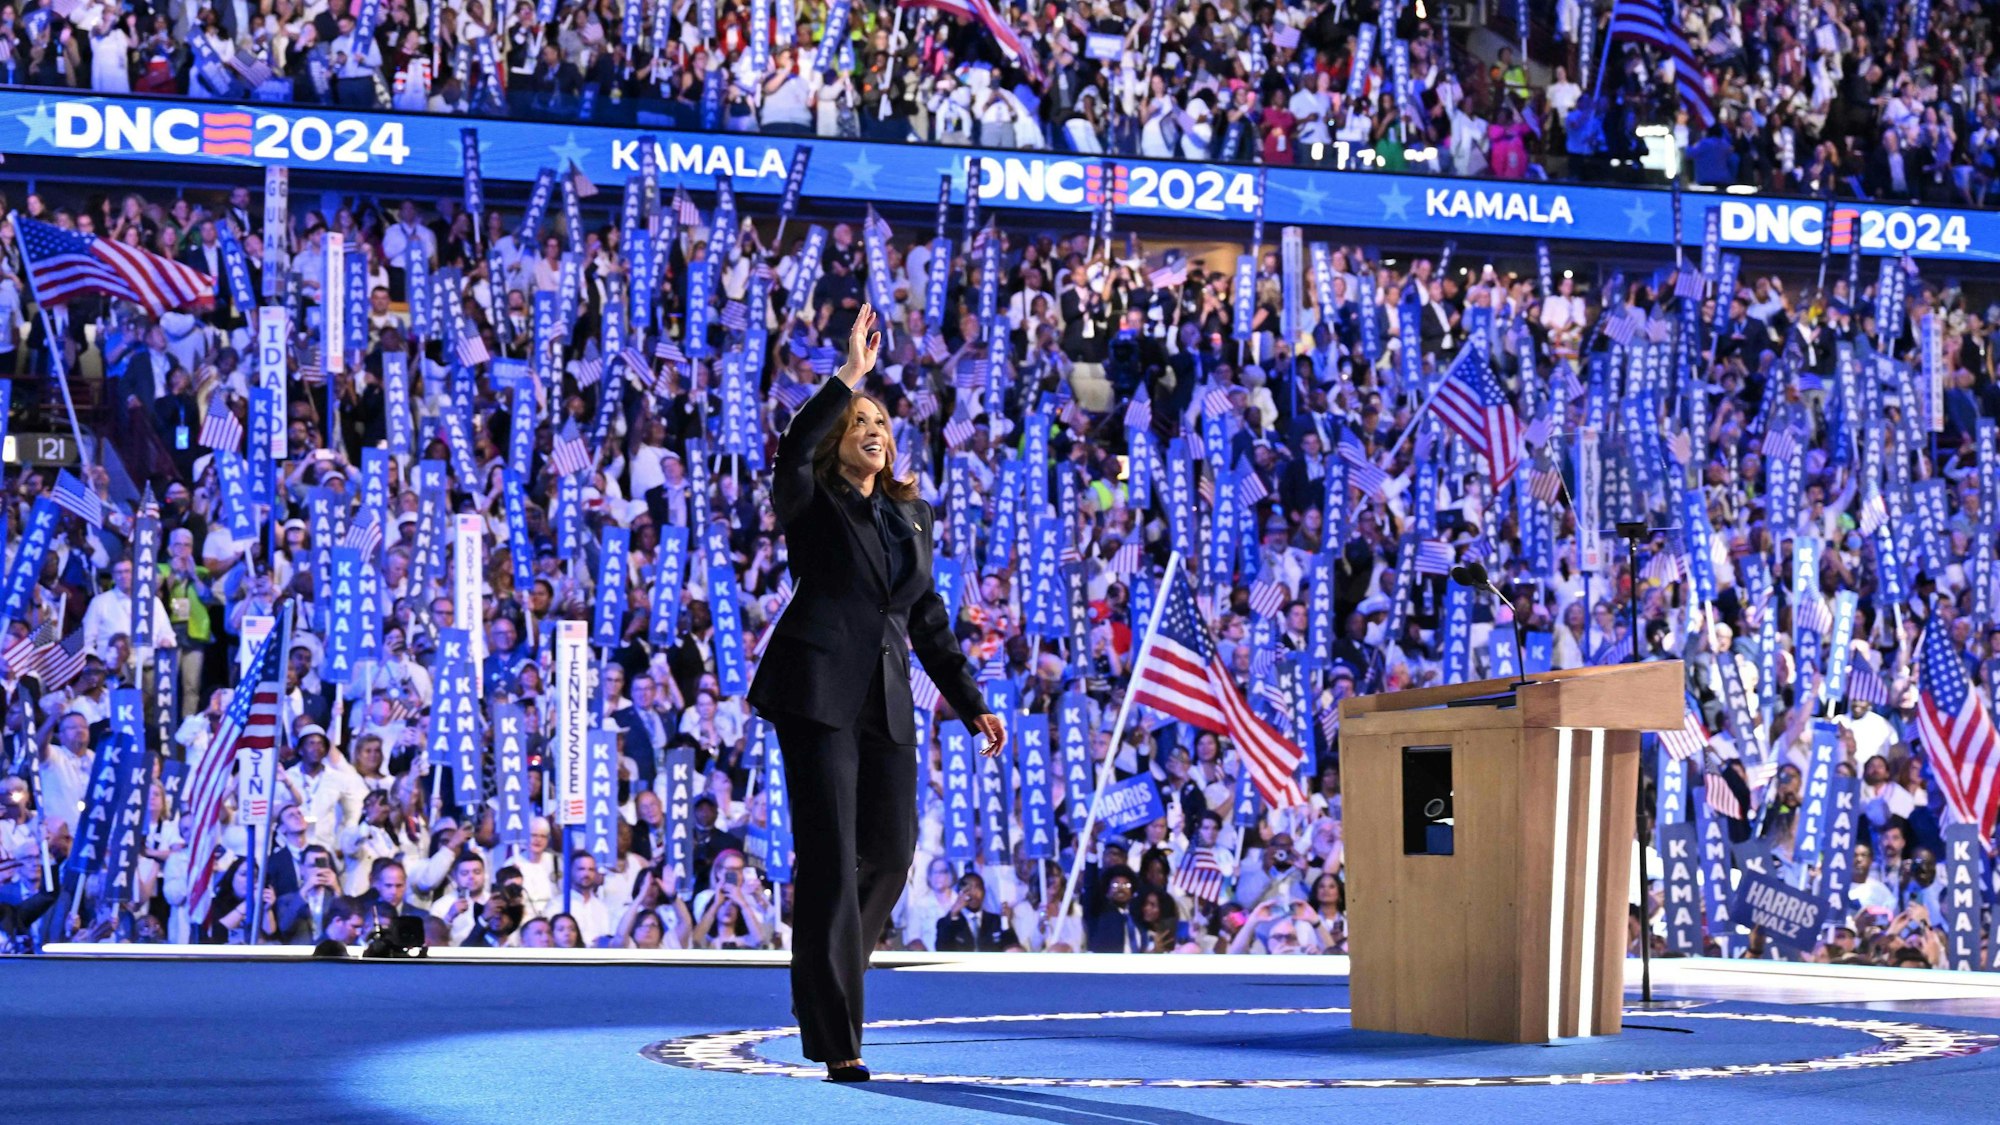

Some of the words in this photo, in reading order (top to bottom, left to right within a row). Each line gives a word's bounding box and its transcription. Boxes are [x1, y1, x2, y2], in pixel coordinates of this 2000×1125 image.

[54, 102, 199, 155] DNC
[254, 115, 410, 165] 2024
[1129, 167, 1258, 214] 2024
[1426, 188, 1574, 225] KAMALA
[1720, 201, 1823, 246] DNC
[1860, 210, 1971, 252] 2024
[352, 262, 363, 341] KAMALA
[410, 249, 427, 326] KAMALA
[634, 238, 647, 318] KAMALA
[690, 271, 705, 350] KAMALA
[928, 246, 947, 318] KAMALA
[1239, 263, 1253, 334] KAMALA
[1315, 248, 1336, 316] KAMALA
[1360, 284, 1377, 353] KAMALA
[991, 325, 1006, 408] KAMALA
[1402, 312, 1419, 382] KAMALA
[253, 399, 268, 493] KAMALA
[388, 361, 406, 445] KAMALA
[515, 388, 532, 475] KAMALA
[727, 362, 743, 444] KAMALA
[1693, 388, 1706, 461] KAMALA
[1898, 370, 1922, 441] KAMALA
[37, 438, 65, 459] 121
[446, 414, 478, 485] KAMALA
[1029, 424, 1043, 506] KAMALA
[507, 481, 530, 578] KAMALA
[951, 467, 968, 555] KAMALA
[993, 471, 1017, 557] KAMALA
[1172, 459, 1190, 548] KAMALA
[1214, 484, 1234, 574] KAMALA
[1327, 464, 1344, 549] KAMALA
[1690, 503, 1712, 590] KAMALA
[1914, 491, 1940, 569] KAMALA
[6, 511, 52, 609] KAMALA
[138, 530, 153, 635] KAMALA
[601, 540, 623, 636] KAMALA
[655, 538, 681, 633] KAMALA
[1033, 530, 1057, 625] KAMALA
[1975, 533, 1990, 614] KAMALA
[333, 561, 352, 671] KAMALA
[715, 581, 740, 683] KAMALA
[1070, 572, 1088, 668] KAMALA
[1315, 566, 1329, 659] KAMALA
[1762, 606, 1775, 698] KAMALA
[1830, 602, 1852, 690] KAMALA
[157, 658, 172, 757] KAMALA
[456, 677, 477, 791] KAMALA
[569, 644, 581, 794] TENNESSEE
[1722, 663, 1759, 755] KAMALA
[79, 744, 122, 861] KAMALA
[502, 717, 523, 830] KAMALA
[592, 743, 611, 854] KAMALA
[948, 735, 968, 848] KAMALA
[1024, 729, 1048, 845] KAMALA
[1063, 707, 1088, 819] KAMALA
[1801, 745, 1832, 851] KAMALA
[112, 767, 146, 888] KAMALA
[671, 763, 688, 879] KAMALA
[769, 748, 782, 867] KAMALA
[1829, 792, 1853, 910] KAMALA
[1746, 881, 1819, 929] HARRIS
[1751, 908, 1801, 939] WALZ
